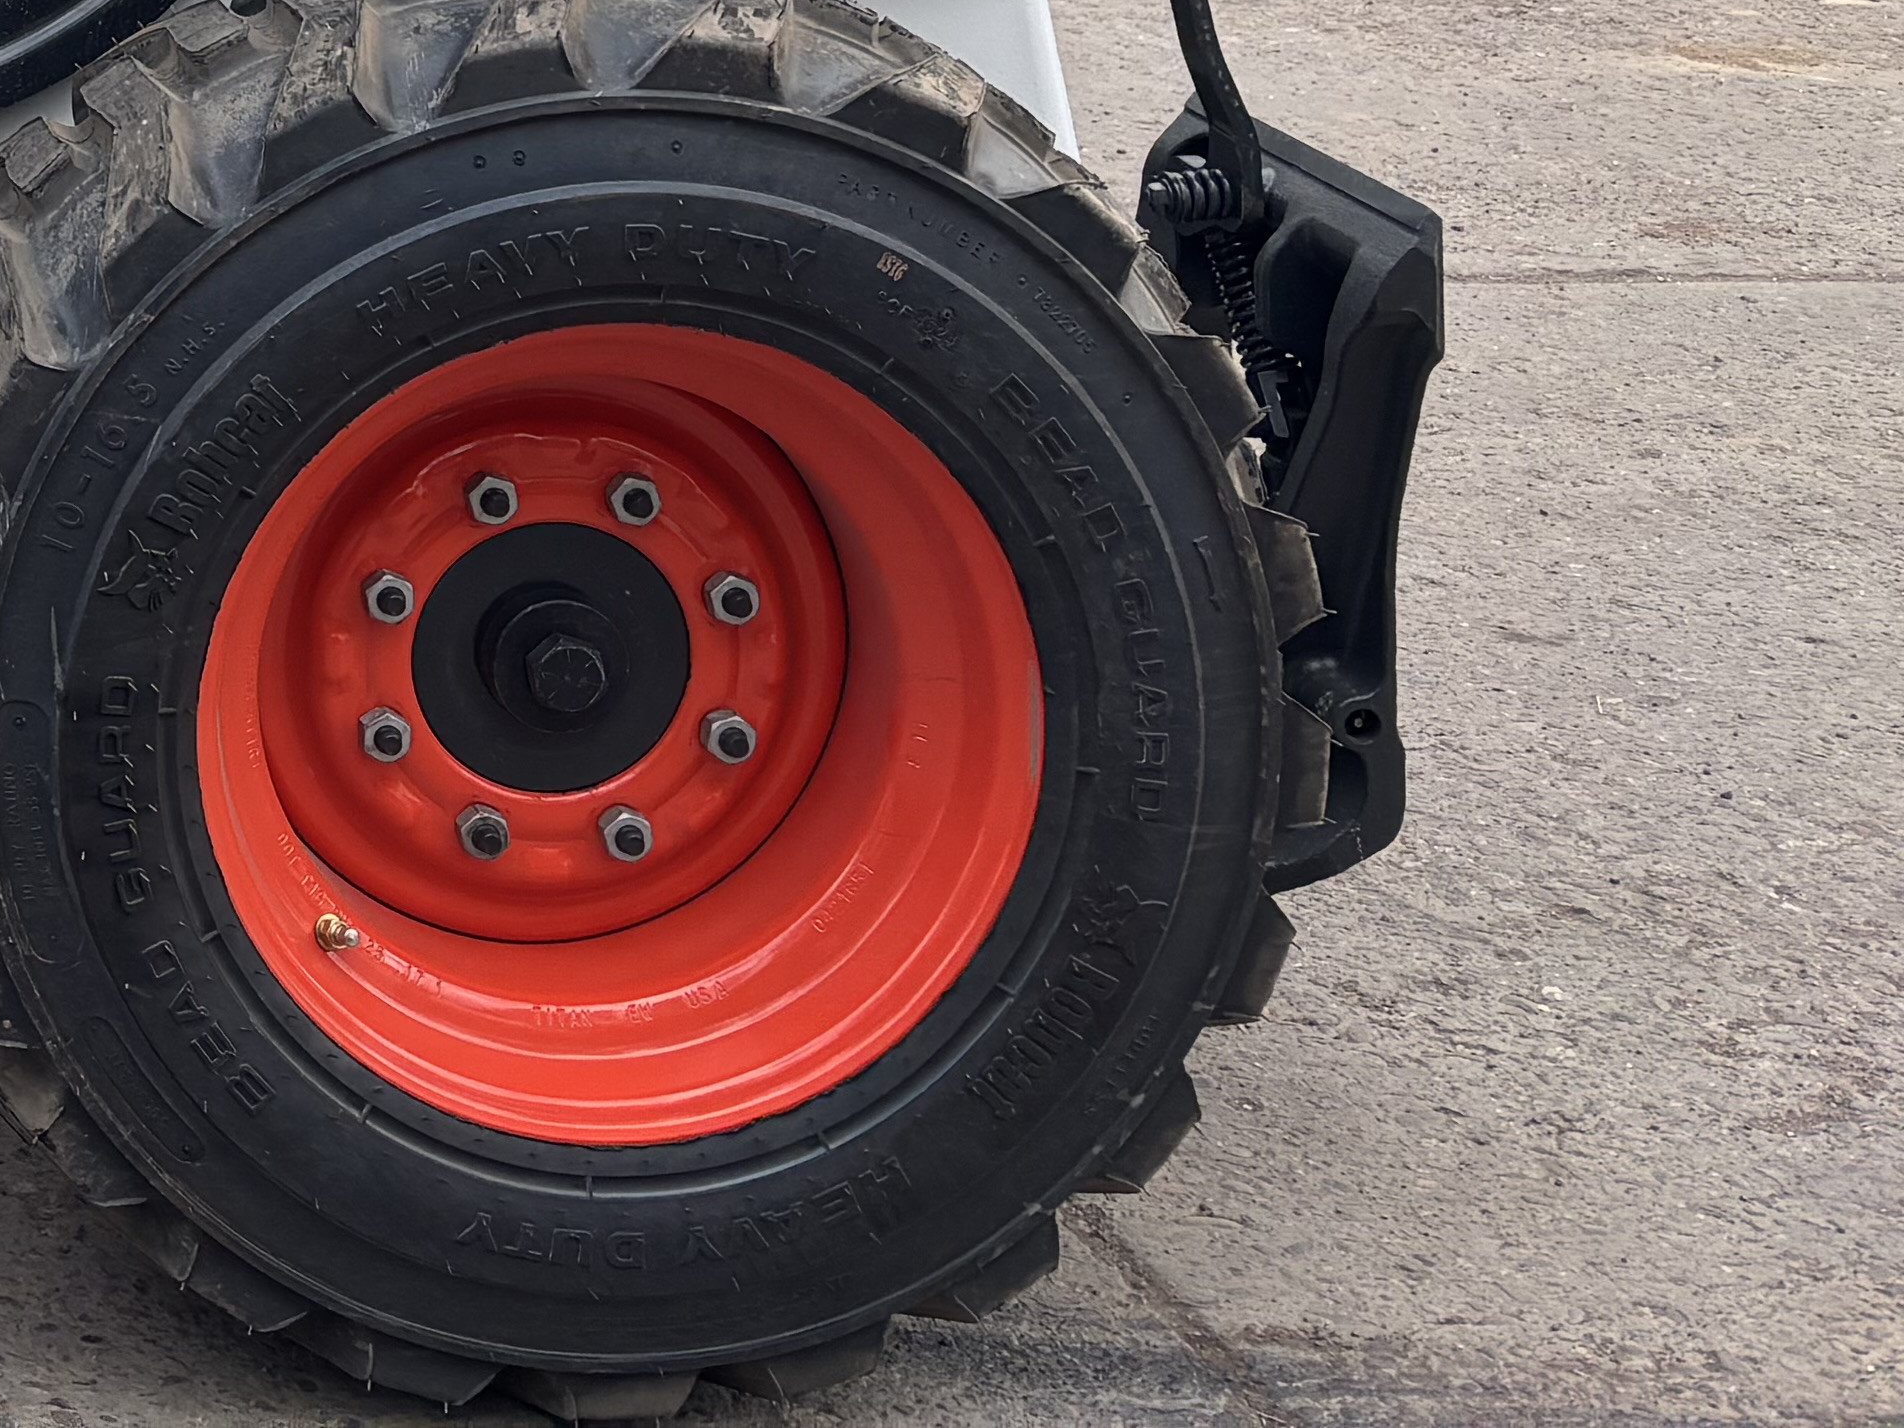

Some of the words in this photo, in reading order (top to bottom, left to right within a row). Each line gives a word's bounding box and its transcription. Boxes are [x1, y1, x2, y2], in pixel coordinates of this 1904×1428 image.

[353, 224, 593, 340] HEAVY
[623, 214, 818, 294] DUTY
[985, 362, 1130, 558] BEAD
[1110, 572, 1170, 825] GUARD
[96, 669, 165, 914] GUARD
[135, 934, 279, 1118] BEAD
[532, 1005, 595, 1029] TITAN
[686, 980, 729, 1010] USA
[451, 1203, 648, 1271] DUTY
[674, 1152, 915, 1269] HEAVY
